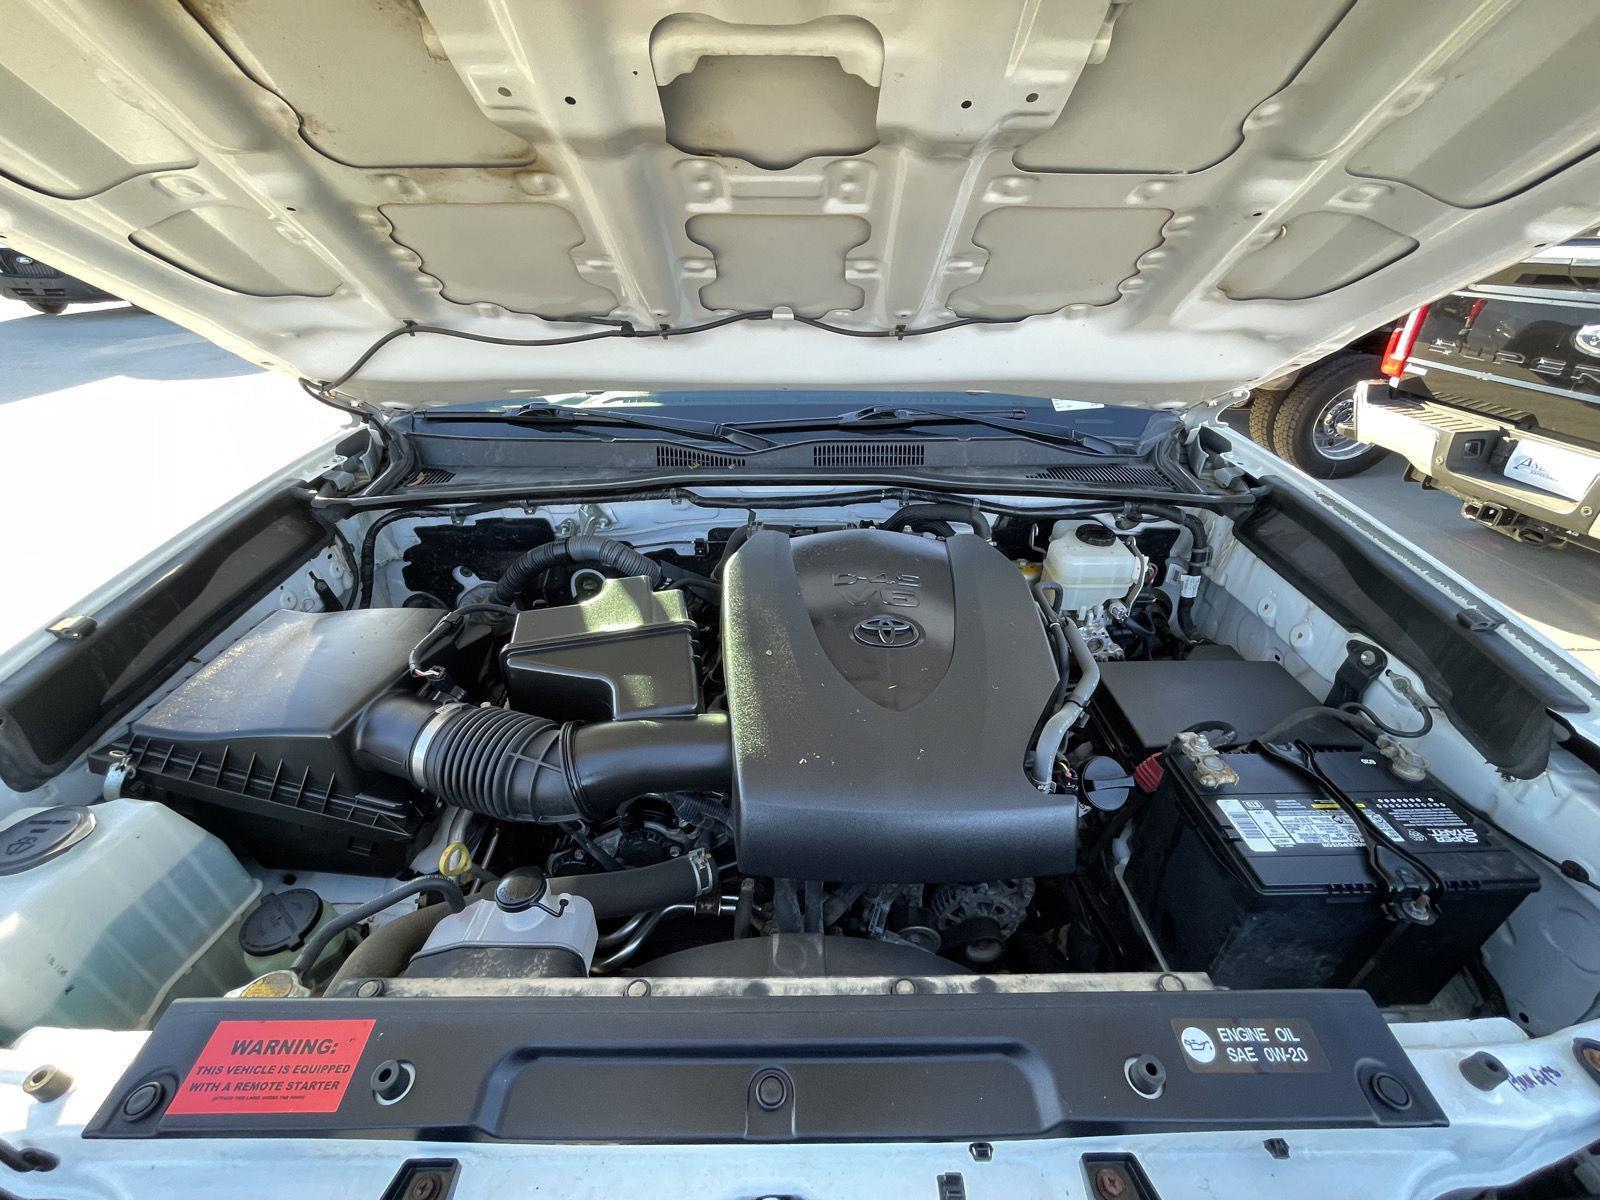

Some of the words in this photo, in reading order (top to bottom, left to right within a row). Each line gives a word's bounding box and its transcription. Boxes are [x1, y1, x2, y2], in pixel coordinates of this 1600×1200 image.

[837, 589, 920, 607] V6
[1427, 828, 1477, 837] START
[1435, 835, 1478, 843] SUPER
[1216, 1027, 1270, 1042] ENGINE
[1274, 1027, 1300, 1042] OIL
[230, 1038, 338, 1055] WARNING:
[1226, 1047, 1259, 1062] SAE
[1263, 1047, 1309, 1062] 0W-20
[196, 1065, 223, 1075] THIS
[227, 1065, 275, 1075] VEHICLE
[278, 1064, 290, 1074] IS
[292, 1064, 351, 1074] EQUIPPED
[189, 1082, 220, 1092] WITH
[222, 1082, 231, 1091] A
[235, 1081, 283, 1091] REMOTE
[286, 1080, 340, 1090] STARTER
